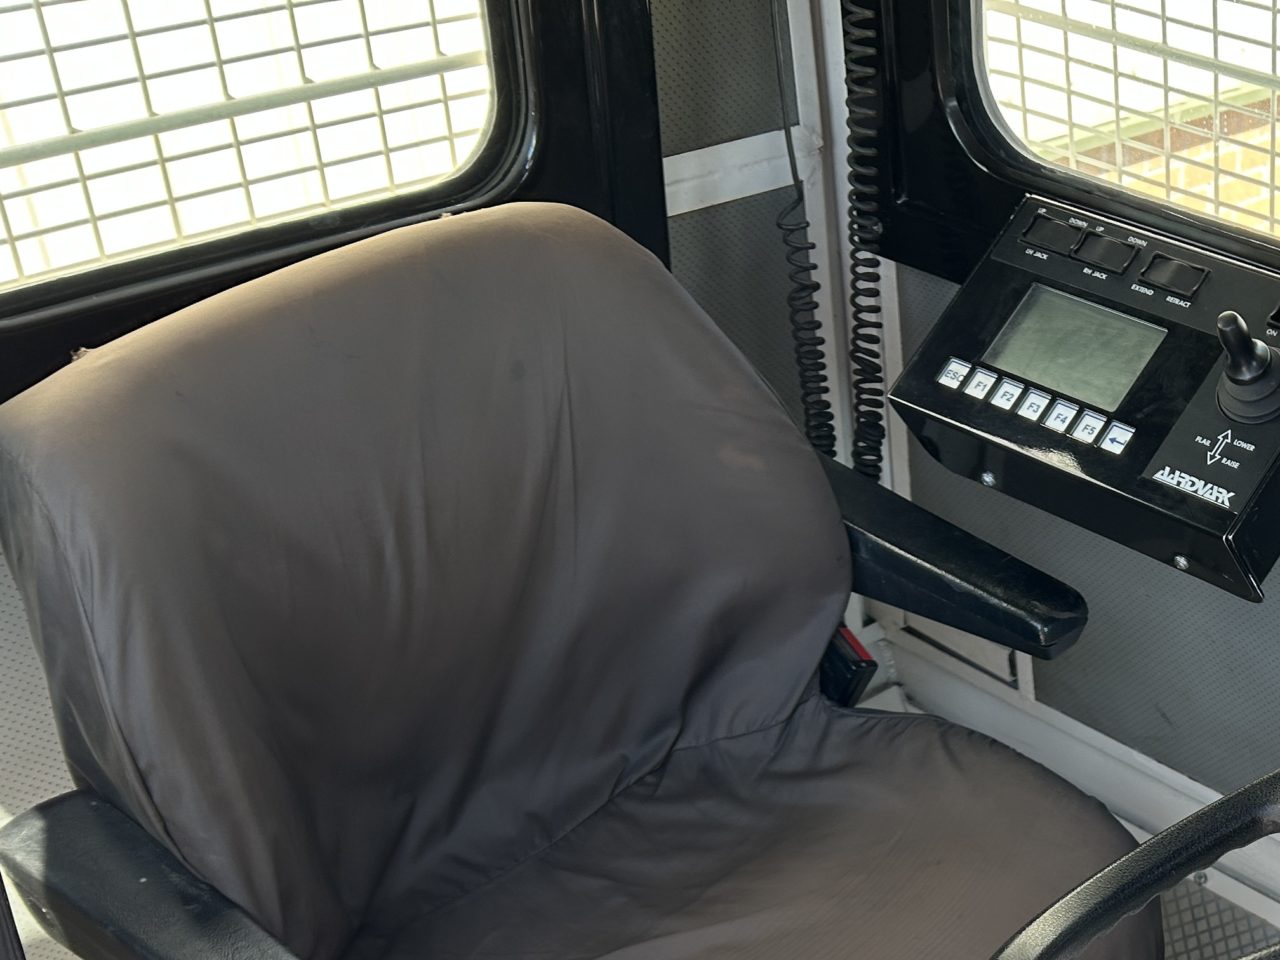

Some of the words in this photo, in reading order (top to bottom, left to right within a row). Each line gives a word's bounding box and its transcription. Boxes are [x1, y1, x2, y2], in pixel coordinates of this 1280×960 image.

[1068, 217, 1088, 228] DOWN
[1127, 236, 1148, 247] DOWN
[1033, 251, 1049, 260] JACK
[1092, 270, 1108, 280] JACK
[1130, 284, 1154, 296] EXTEND
[1166, 296, 1191, 308] RETRACT
[1266, 328, 1278, 337] ON
[944, 369, 965, 383] ESC
[973, 381, 987, 392] F1
[1000, 391, 1014, 402] F2
[1027, 402, 1041, 414] F3
[1054, 413, 1068, 425] F4
[1081, 424, 1096, 436] F5
[1233, 439, 1256, 451] LOWER
[1221, 457, 1240, 469] RAISE
[1152, 466, 1235, 507] AARDVARK
